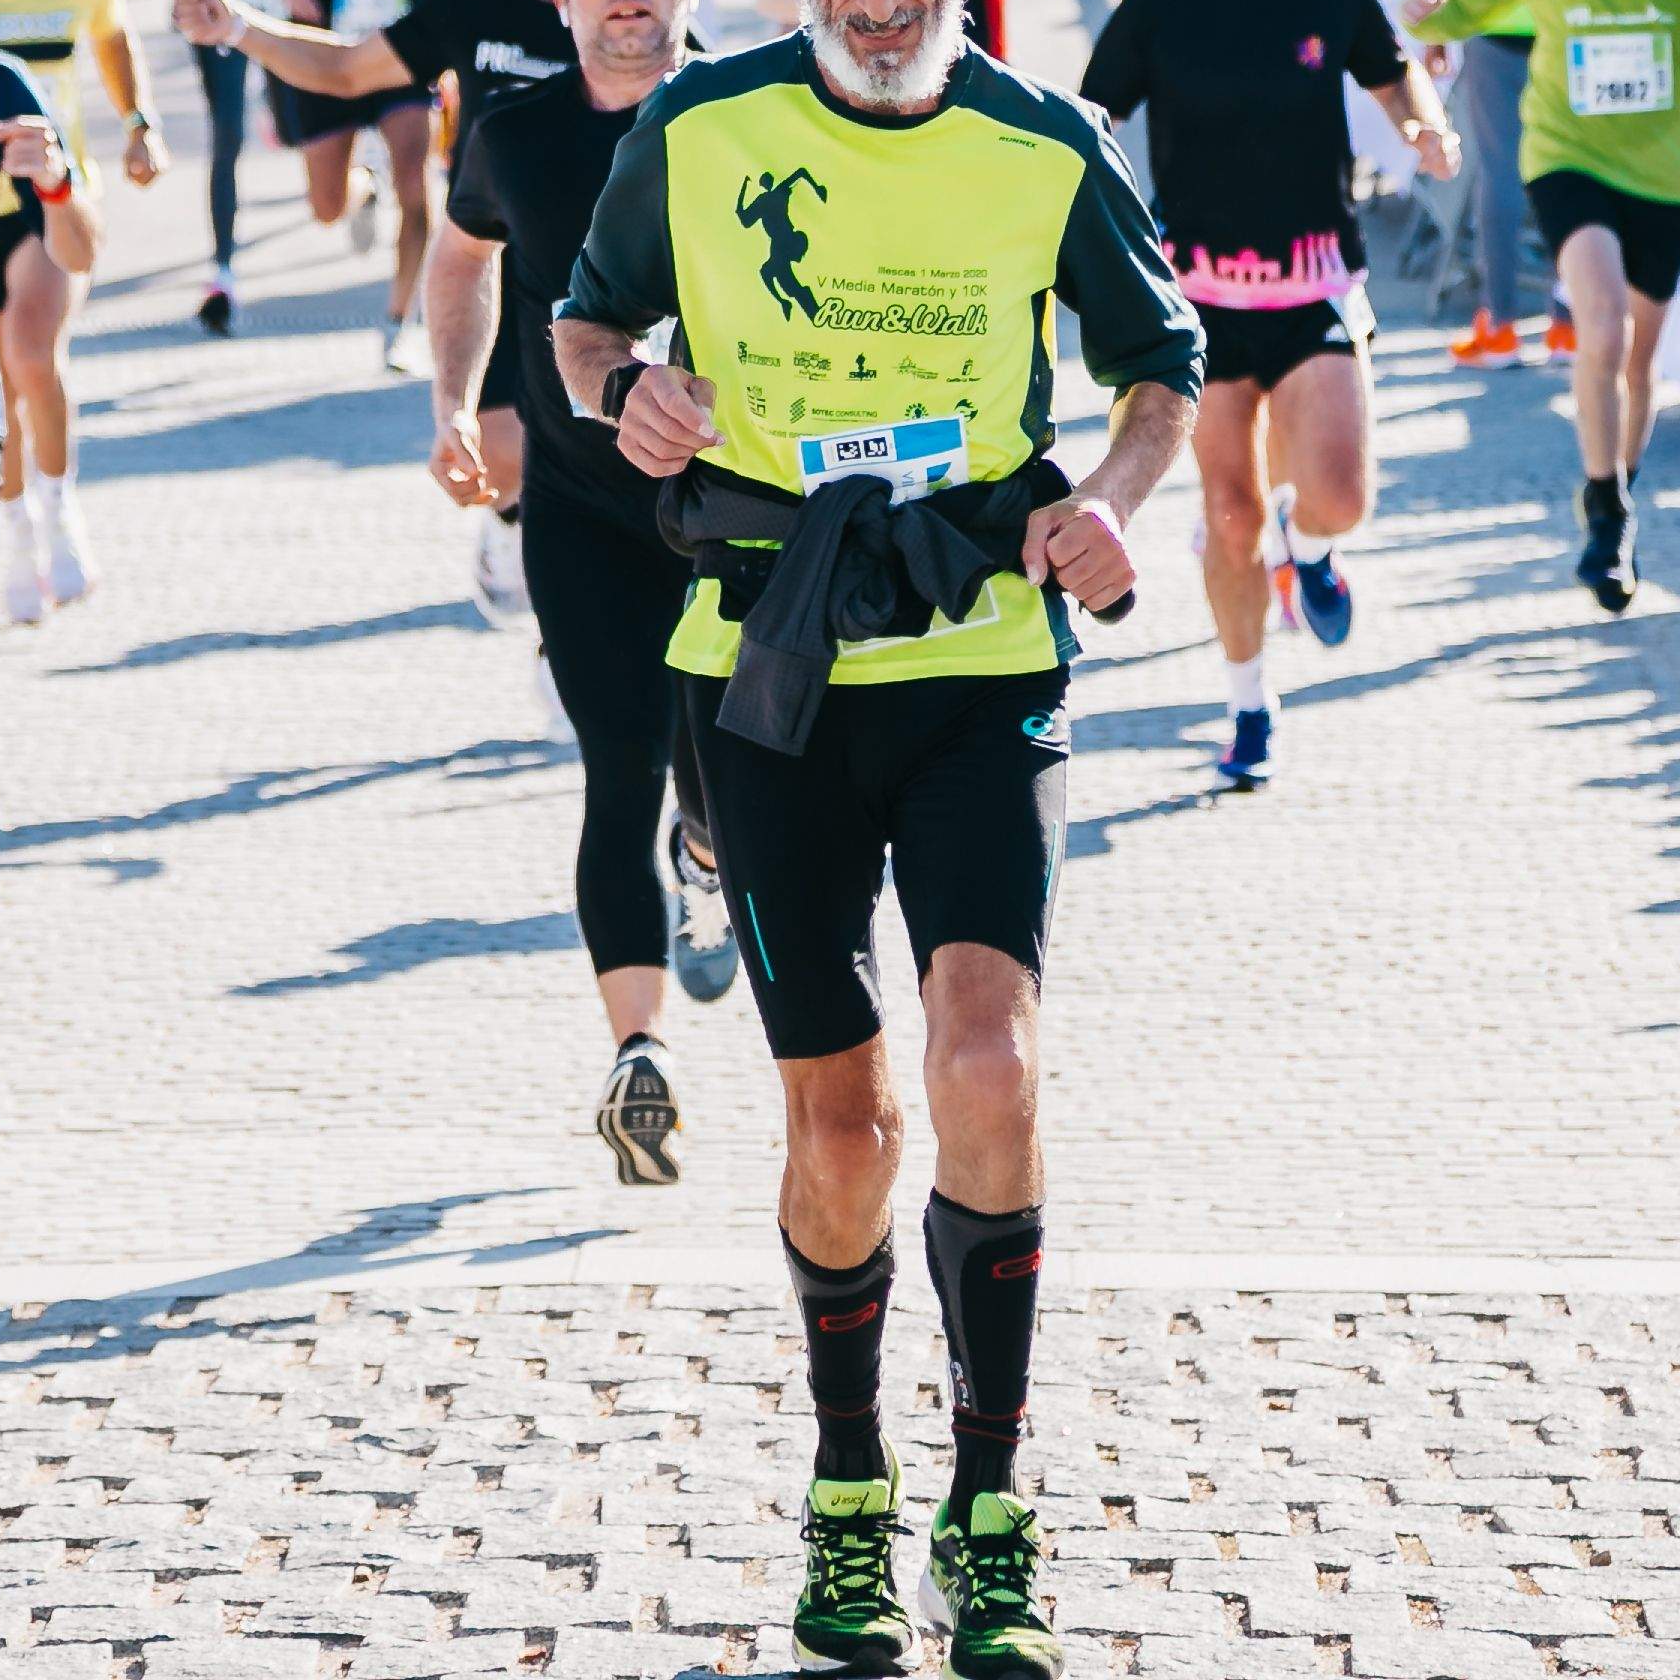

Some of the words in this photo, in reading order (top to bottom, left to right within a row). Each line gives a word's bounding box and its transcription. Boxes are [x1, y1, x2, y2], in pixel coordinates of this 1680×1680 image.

[930, 269, 960, 278] Marzo
[963, 269, 987, 278] 2020
[817, 276, 827, 288] V
[832, 277, 875, 293] Media
[881, 282, 945, 296] Maratón
[950, 287, 957, 299] y
[963, 284, 988, 296] 10K
[813, 297, 987, 335] Run&Walk
